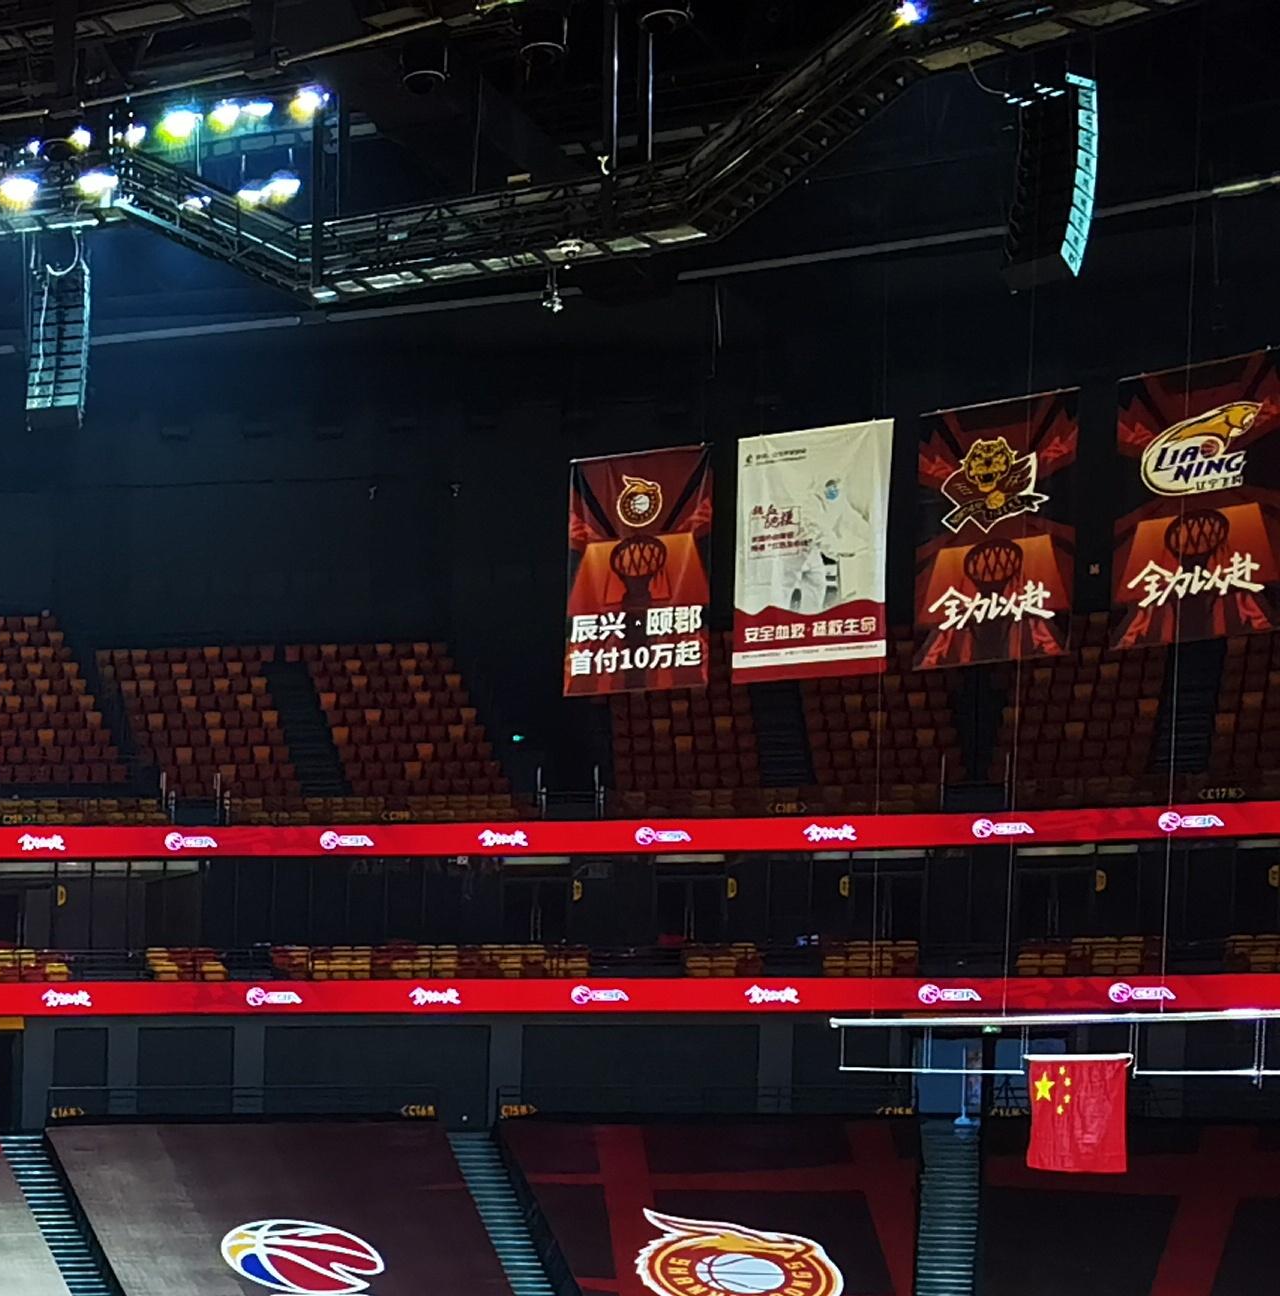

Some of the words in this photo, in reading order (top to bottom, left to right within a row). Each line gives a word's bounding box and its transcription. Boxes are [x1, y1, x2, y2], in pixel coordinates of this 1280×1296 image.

[1127, 552, 1265, 607] 全力以赴
[928, 580, 1055, 630] 全力以赴
[570, 640, 702, 677] 首付10万起
